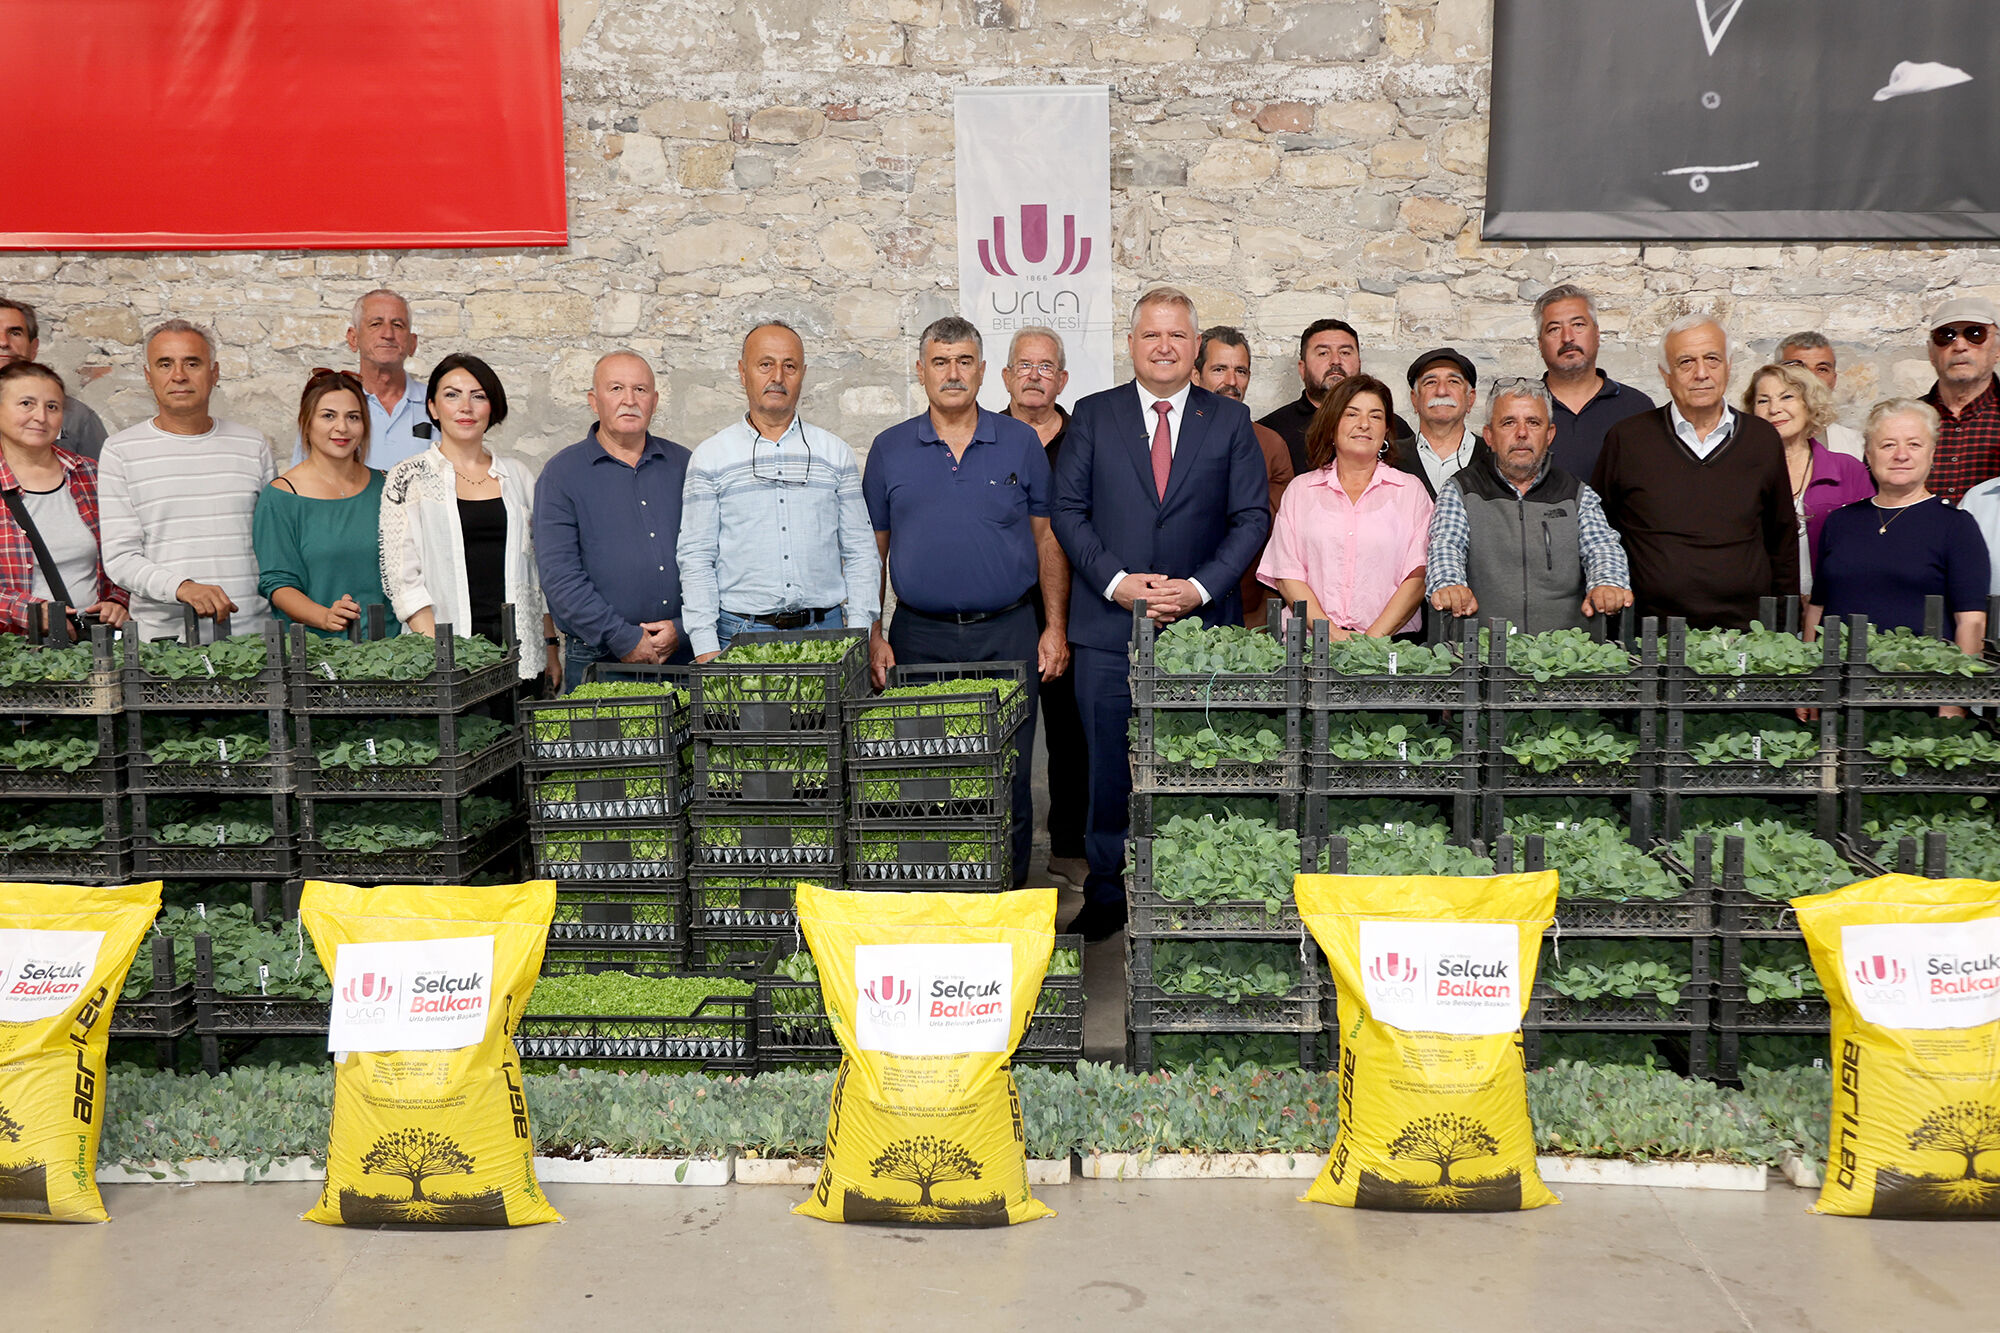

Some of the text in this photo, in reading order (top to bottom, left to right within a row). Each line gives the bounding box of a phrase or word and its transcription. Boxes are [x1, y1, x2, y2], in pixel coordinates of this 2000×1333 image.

[1026, 274, 1048, 282] 1866
[19, 961, 87, 981] Selçuk
[1437, 958, 1509, 980] Selçuk
[10, 980, 79, 995] Balkan
[412, 972, 484, 994] Selçuk
[930, 979, 1003, 1000] Selçuk
[1437, 979, 1510, 998] Balkan
[410, 994, 482, 1013] Balkan
[929, 1000, 1003, 1018] Balkan
